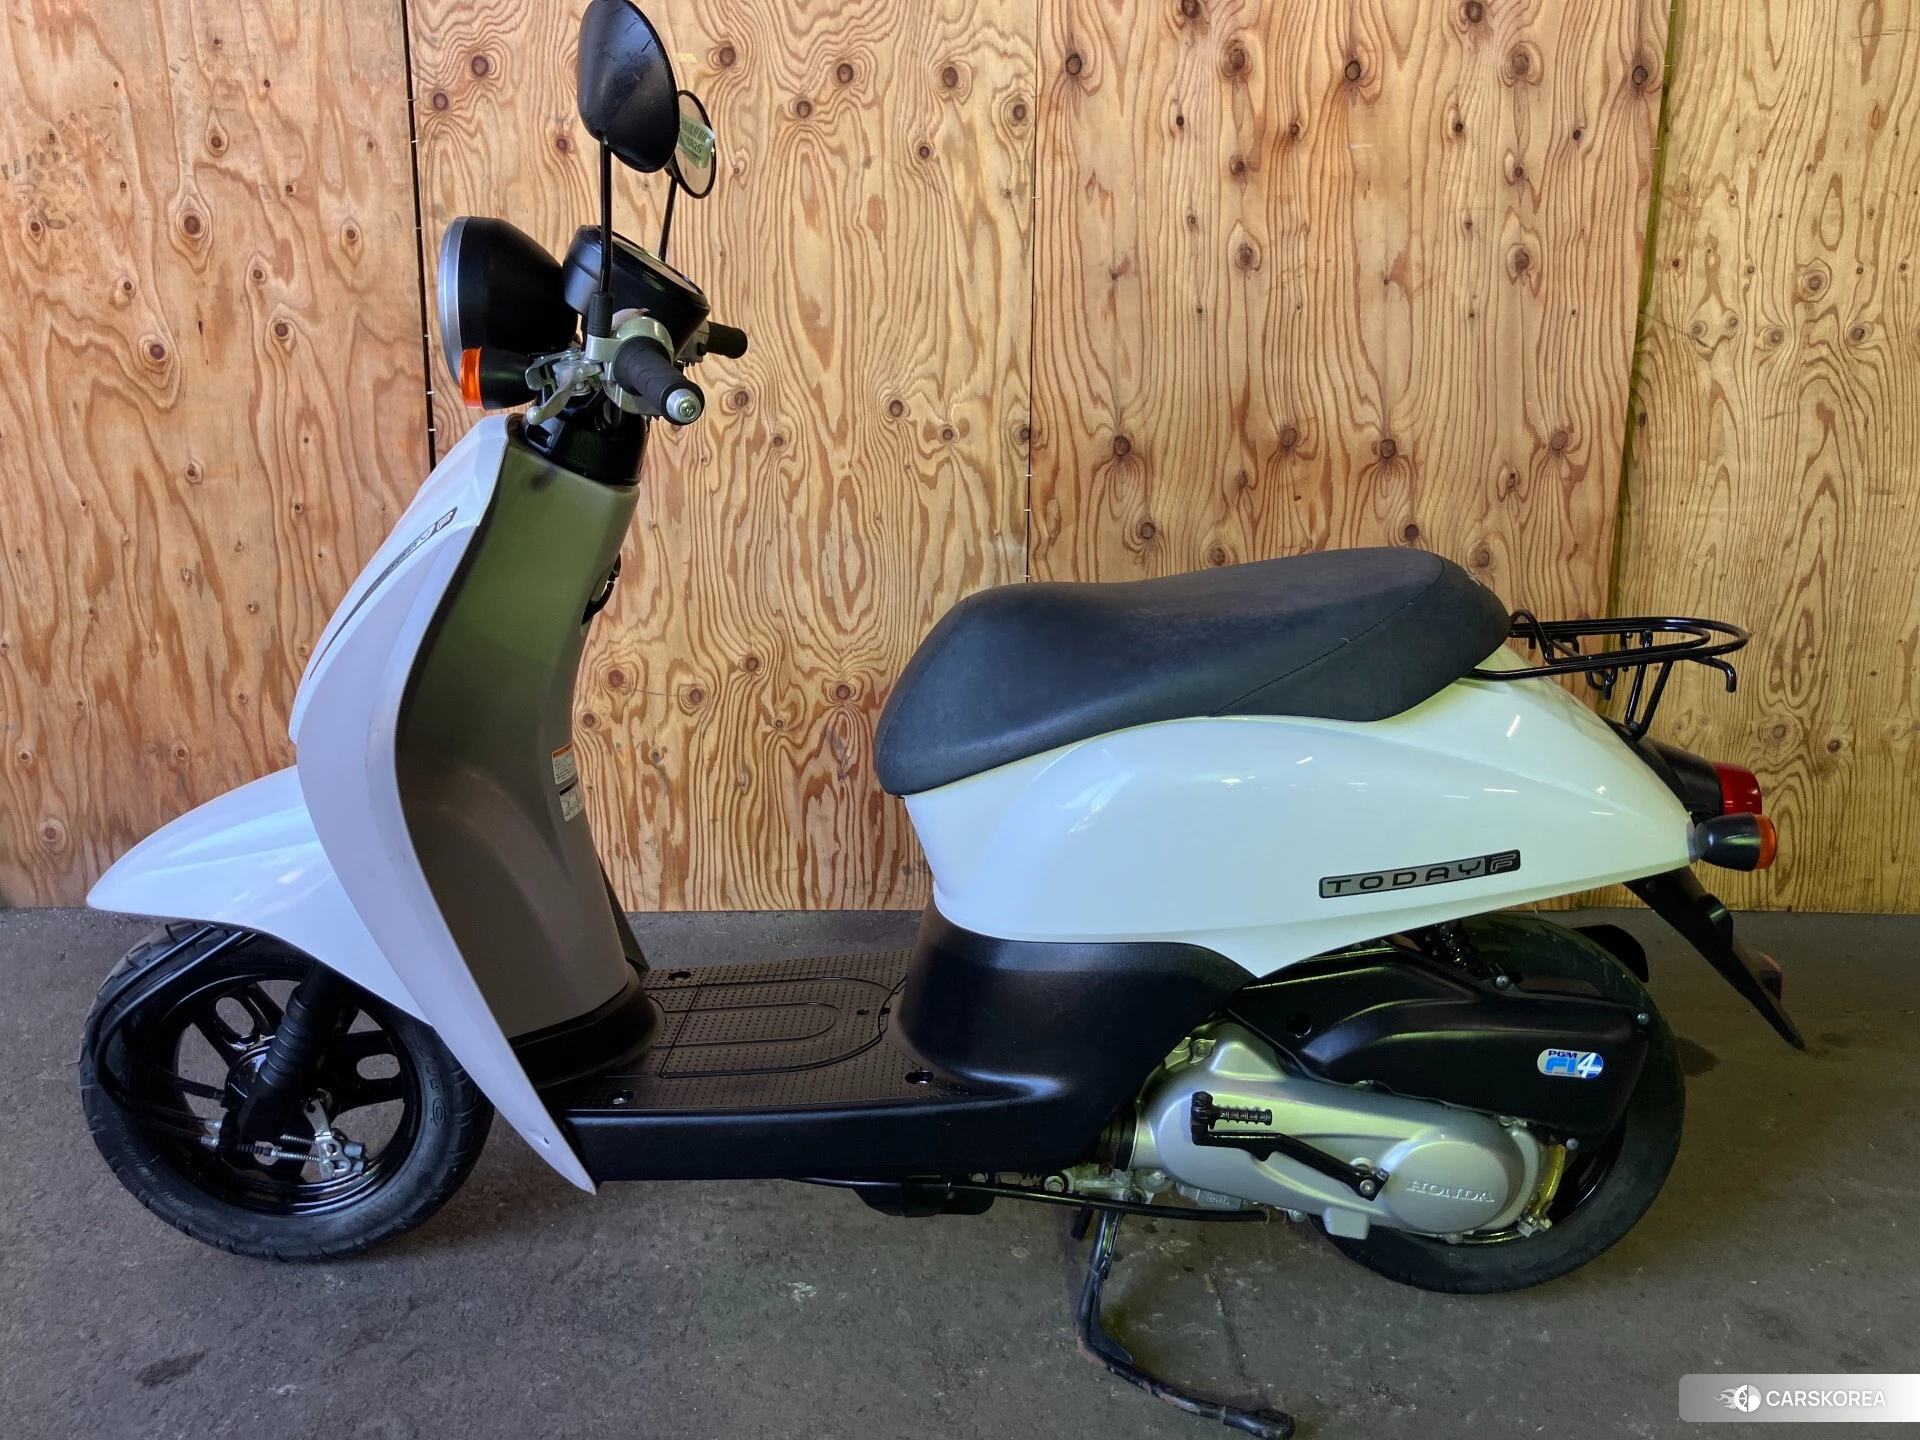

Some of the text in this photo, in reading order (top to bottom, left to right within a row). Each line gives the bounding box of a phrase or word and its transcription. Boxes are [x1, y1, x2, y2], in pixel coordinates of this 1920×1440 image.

[1326, 860, 1482, 893] TODAY
[1548, 1050, 1578, 1059] PGM
[1577, 1052, 1603, 1079] 4
[1406, 1179, 1495, 1203] HONDA
